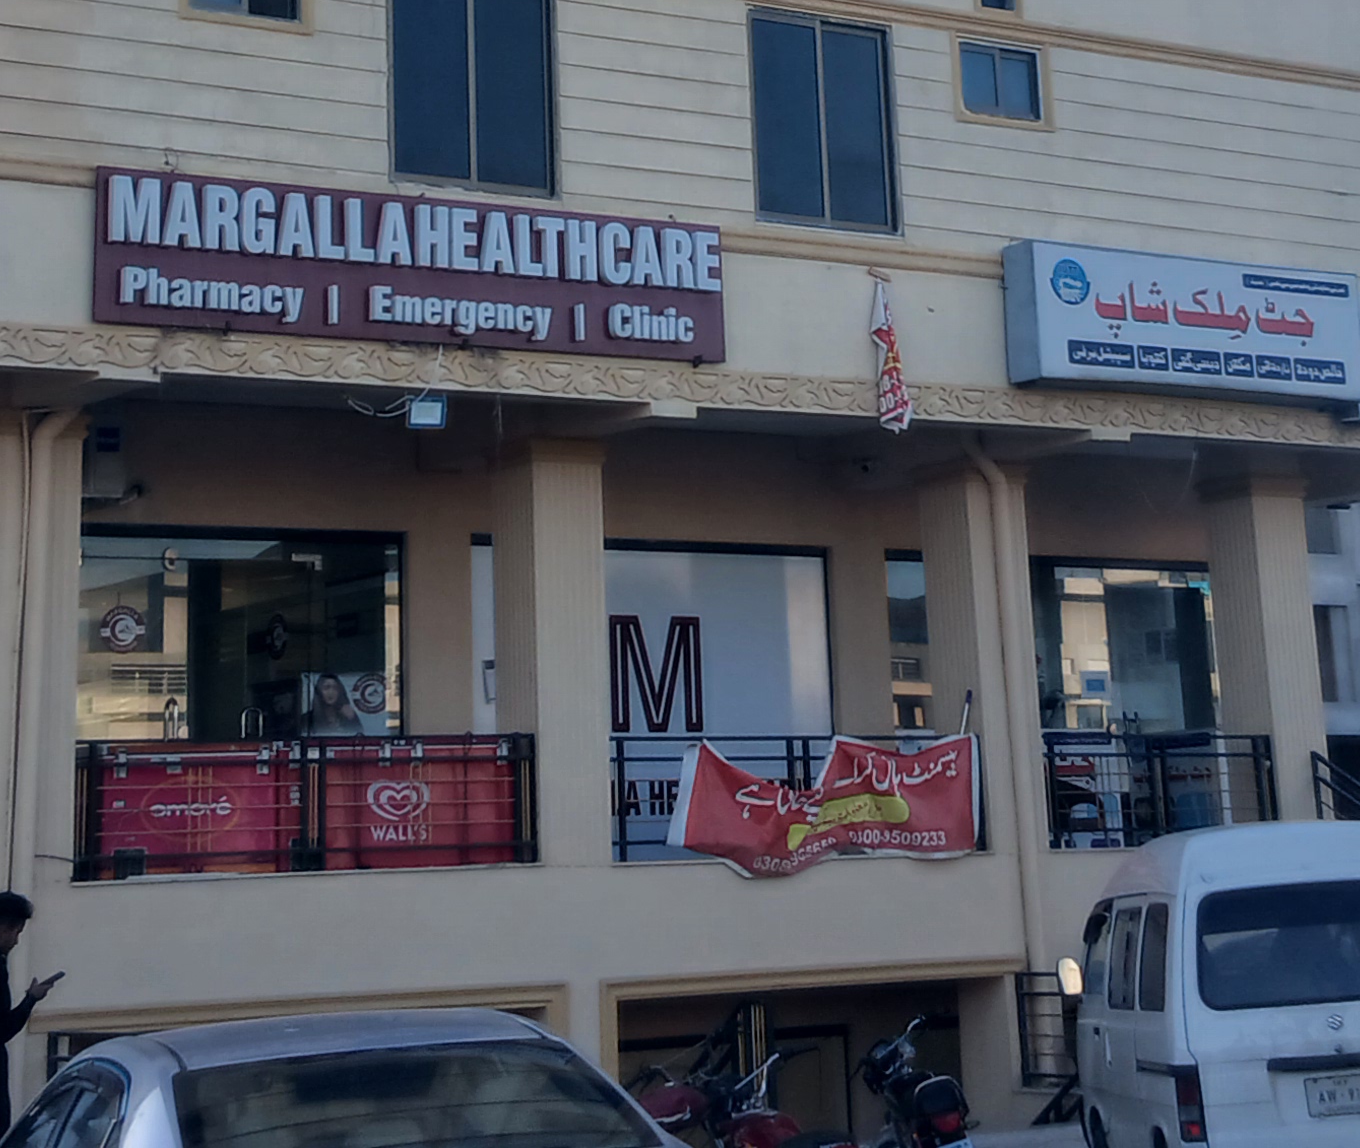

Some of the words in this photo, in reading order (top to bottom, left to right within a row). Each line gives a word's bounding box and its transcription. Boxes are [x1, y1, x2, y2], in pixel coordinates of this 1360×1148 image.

[106, 174, 722, 293] MARGALLAHEALTHCARE
[120, 265, 305, 324] Pharmacy
[369, 285, 552, 343] Emergency
[607, 303, 695, 343] Clinic
[1094, 280, 1170, 340] شاپ
[1255, 296, 1315, 348] جٹ
[609, 615, 703, 732] M
[371, 825, 427, 841] WALL'S
